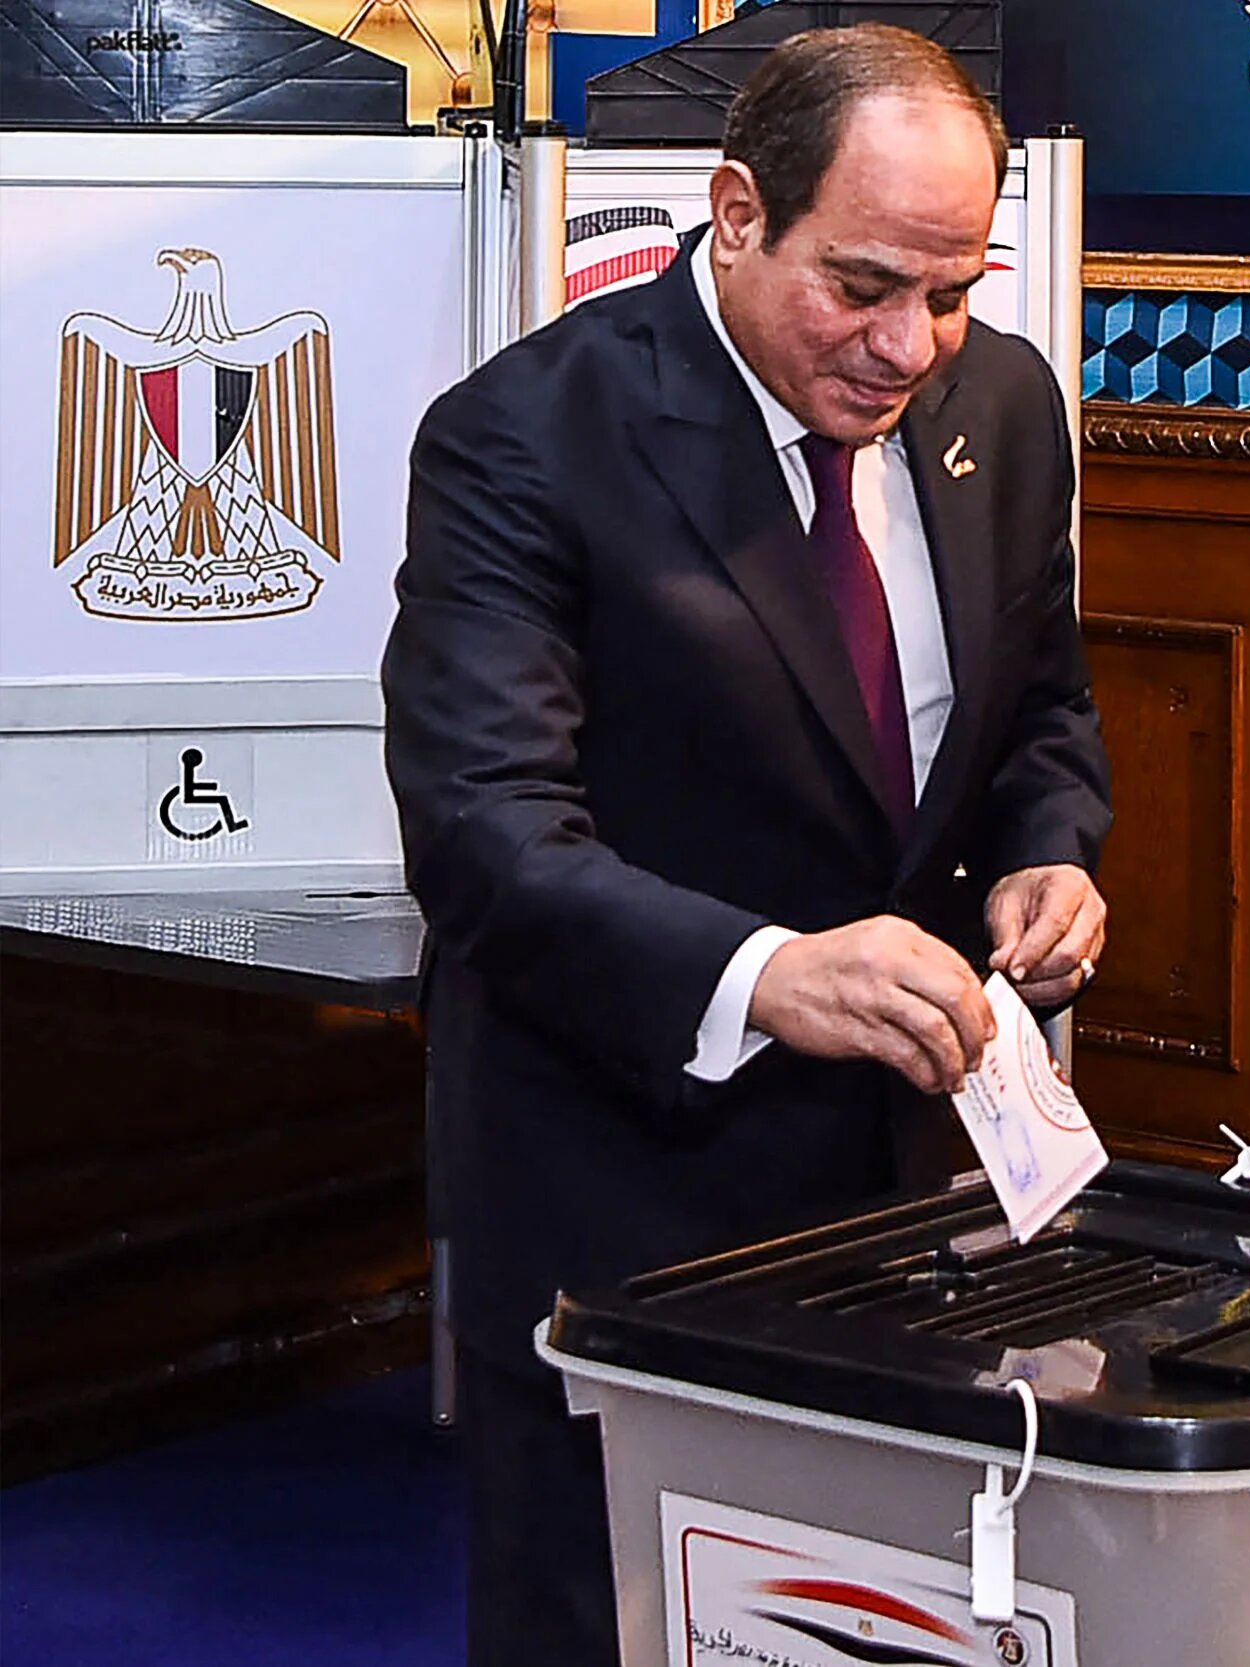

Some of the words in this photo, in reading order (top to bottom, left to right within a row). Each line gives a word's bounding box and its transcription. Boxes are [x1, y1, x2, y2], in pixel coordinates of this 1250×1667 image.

[97, 574, 168, 608] العربية
[161, 592, 212, 611] مصر
[212, 572, 300, 609] جمهورية
